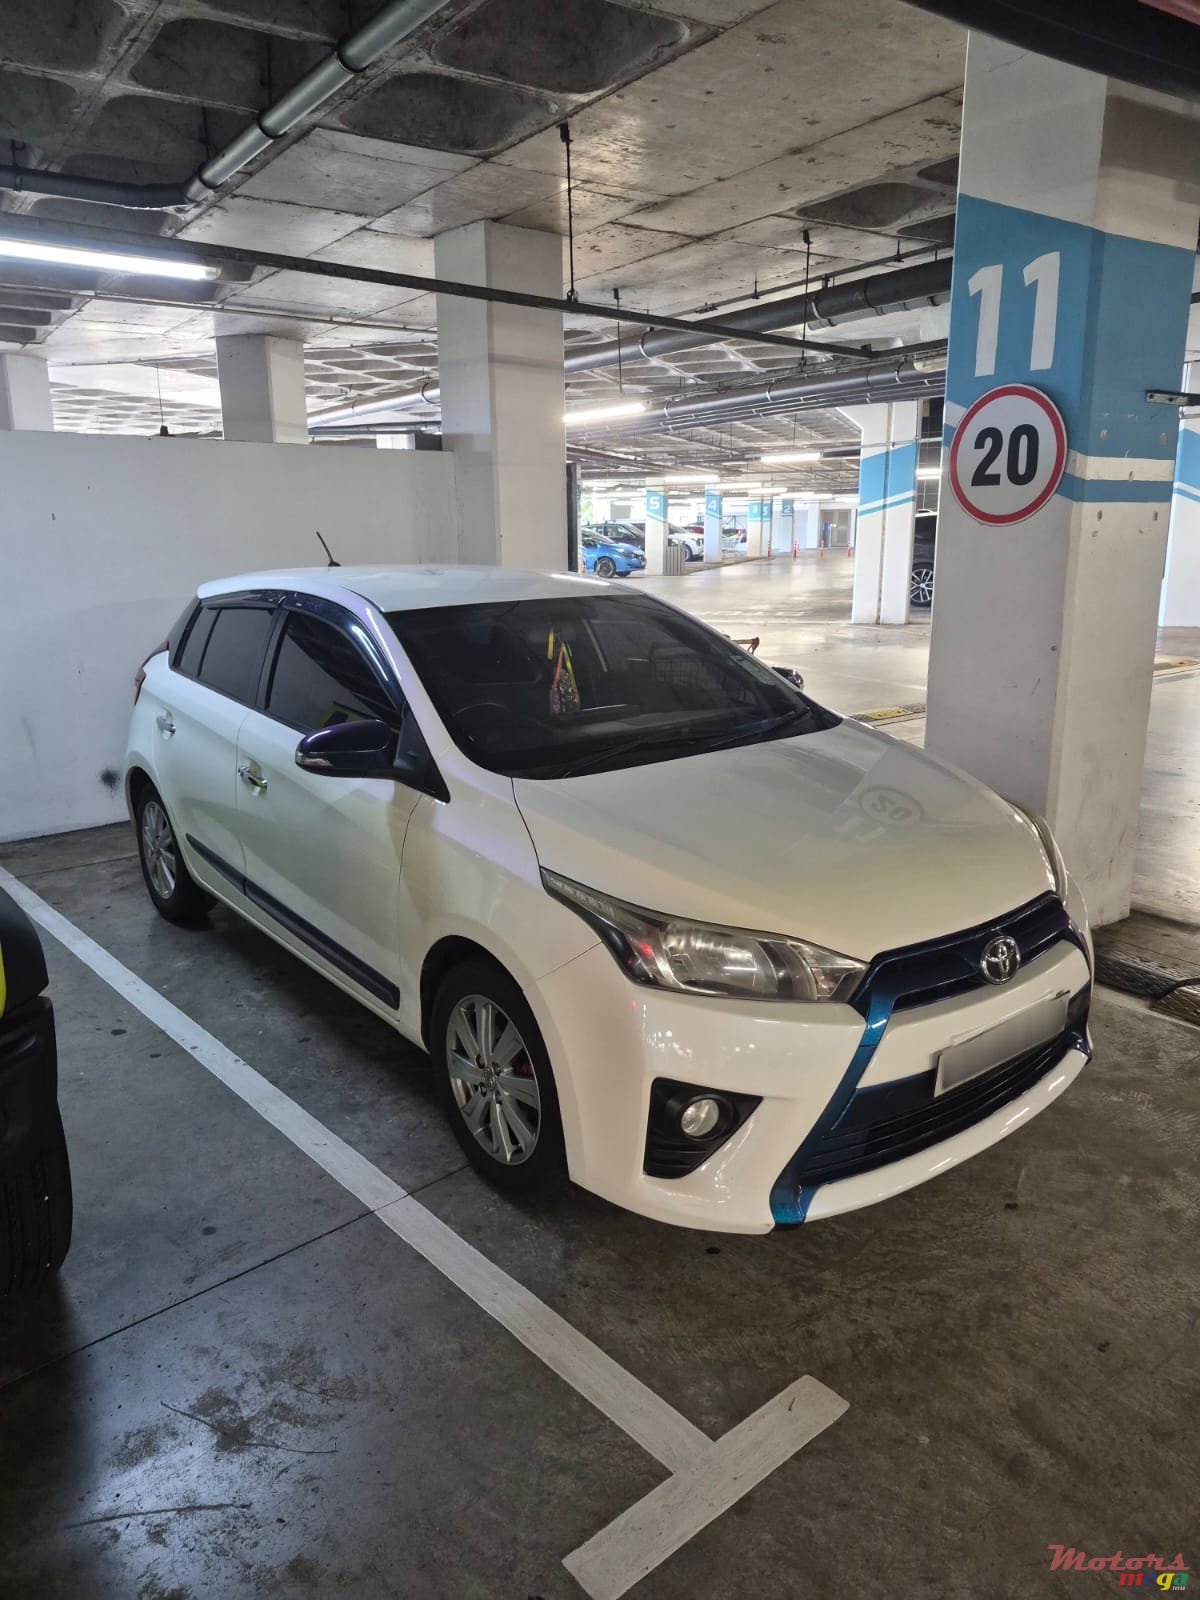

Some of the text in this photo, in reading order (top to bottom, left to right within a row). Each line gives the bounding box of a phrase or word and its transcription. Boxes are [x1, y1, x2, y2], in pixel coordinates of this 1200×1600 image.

[967, 251, 1061, 378] 11
[971, 423, 1040, 487] 20
[649, 496, 660, 510] 5
[707, 499, 717, 511] 4
[783, 504, 791, 513] 2
